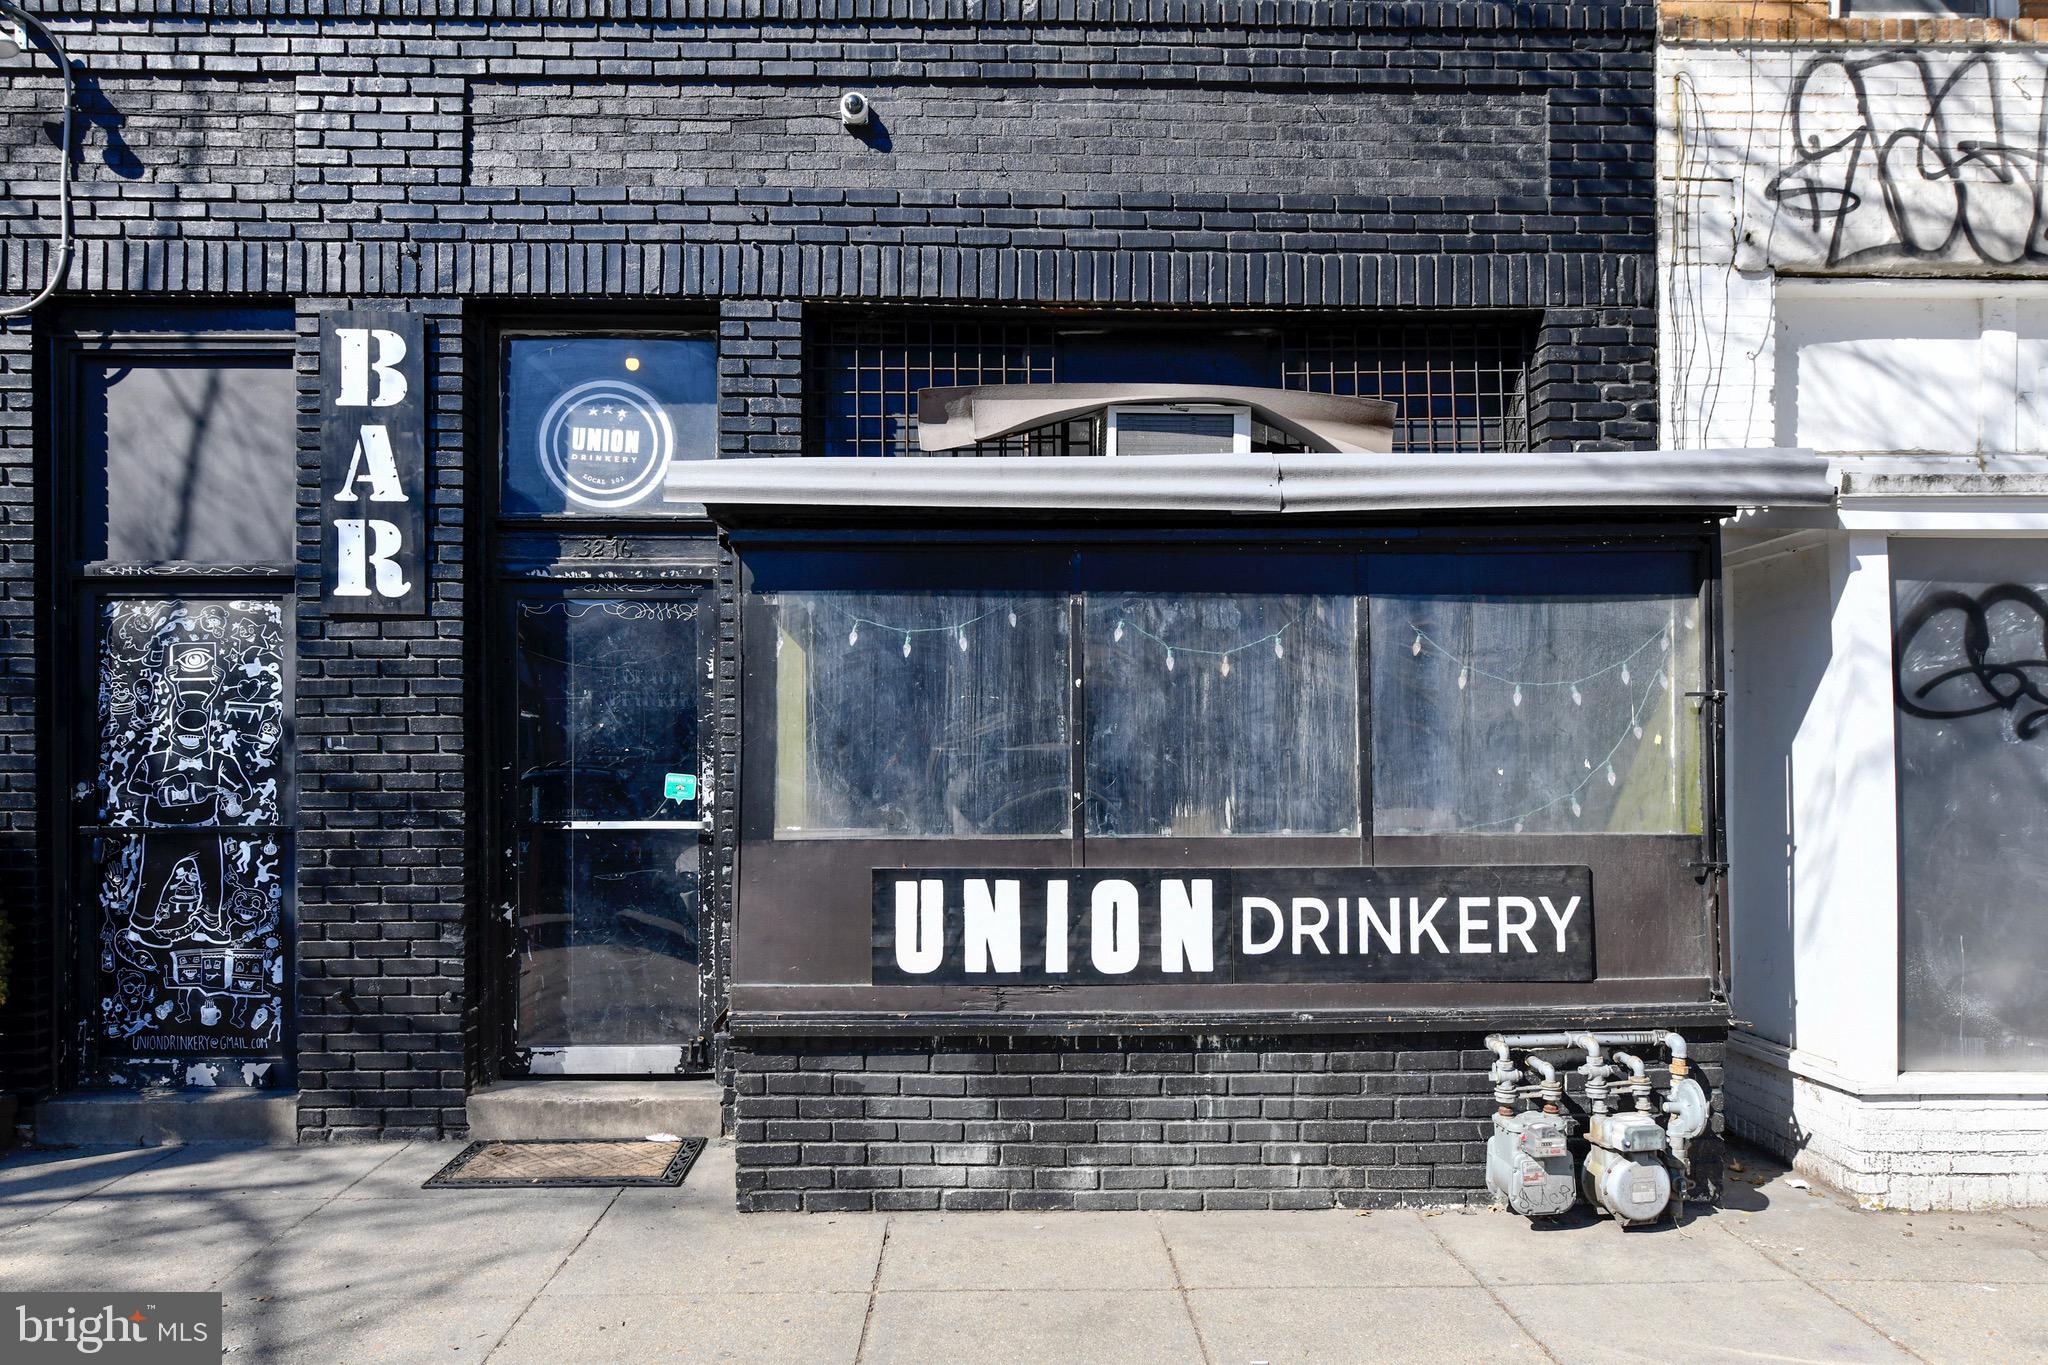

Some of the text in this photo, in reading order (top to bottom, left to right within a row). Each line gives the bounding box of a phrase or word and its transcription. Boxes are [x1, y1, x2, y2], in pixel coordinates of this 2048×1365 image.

[572, 427, 640, 453] UNION
[333, 328, 412, 598] BAR
[571, 454, 637, 463] DRINKERY
[583, 473, 606, 485] LOCAL
[895, 878, 1581, 975] UNION DRINKERY
